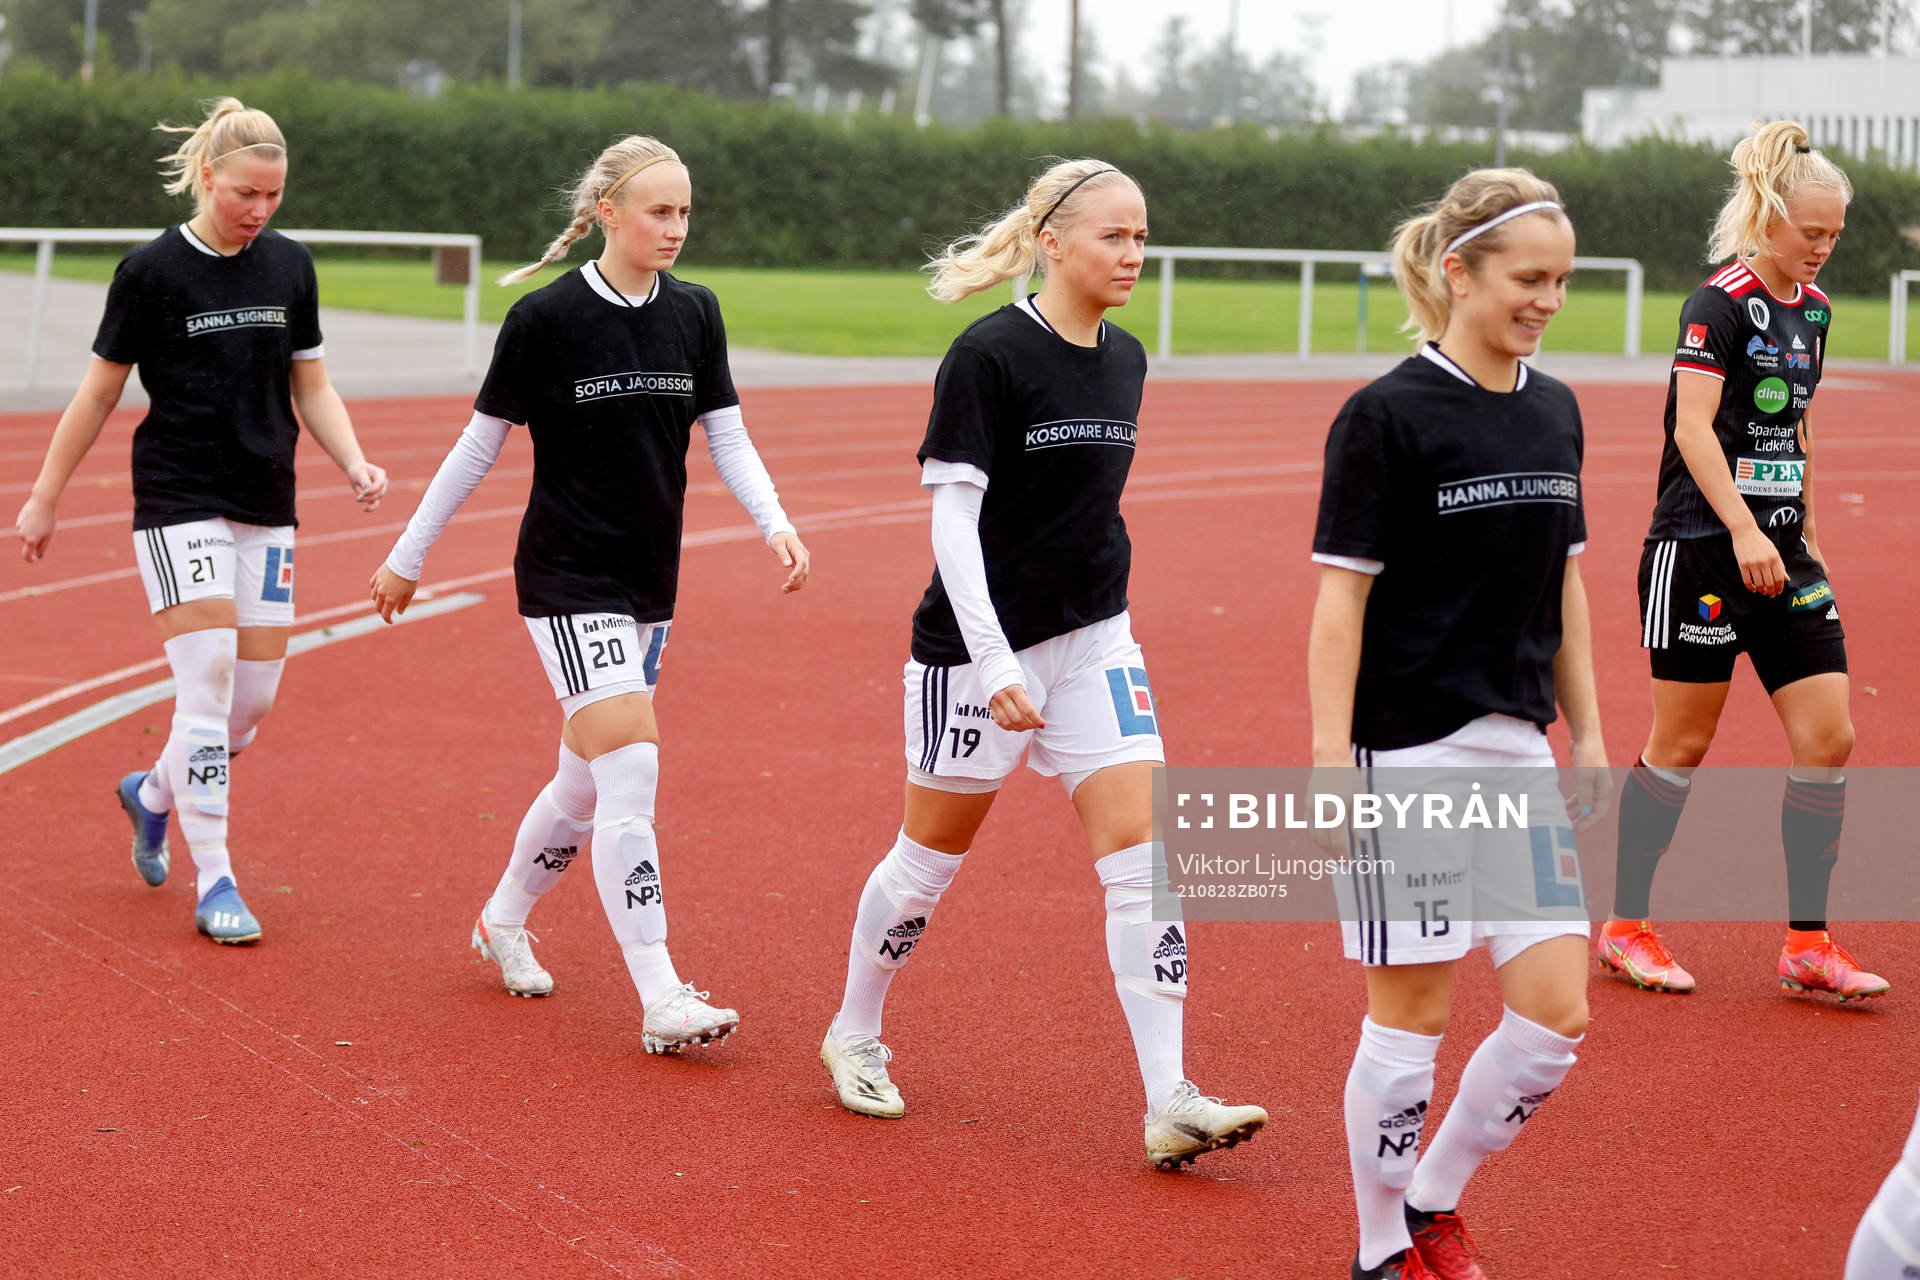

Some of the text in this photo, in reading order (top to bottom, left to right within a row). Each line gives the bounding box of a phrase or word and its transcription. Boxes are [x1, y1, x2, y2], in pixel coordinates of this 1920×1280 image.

[186, 310, 287, 333] SANNA SIGNEUL
[1699, 351, 1715, 360] SPEL
[575, 379, 622, 398] SOFIA
[1757, 387, 1786, 400] dina
[1025, 424, 1102, 446] KOSOVARE
[1747, 421, 1797, 439] Sparban
[1751, 462, 1806, 481] PEA
[1438, 481, 1509, 508] HANNA
[1737, 485, 1773, 493] NORDENS
[190, 556, 215, 583] 21
[589, 638, 626, 669] 20
[972, 705, 994, 720] Mi
[950, 727, 981, 758] 19
[188, 764, 227, 785] NP3
[625, 884, 662, 910] NP3
[1414, 900, 1449, 937] 15
